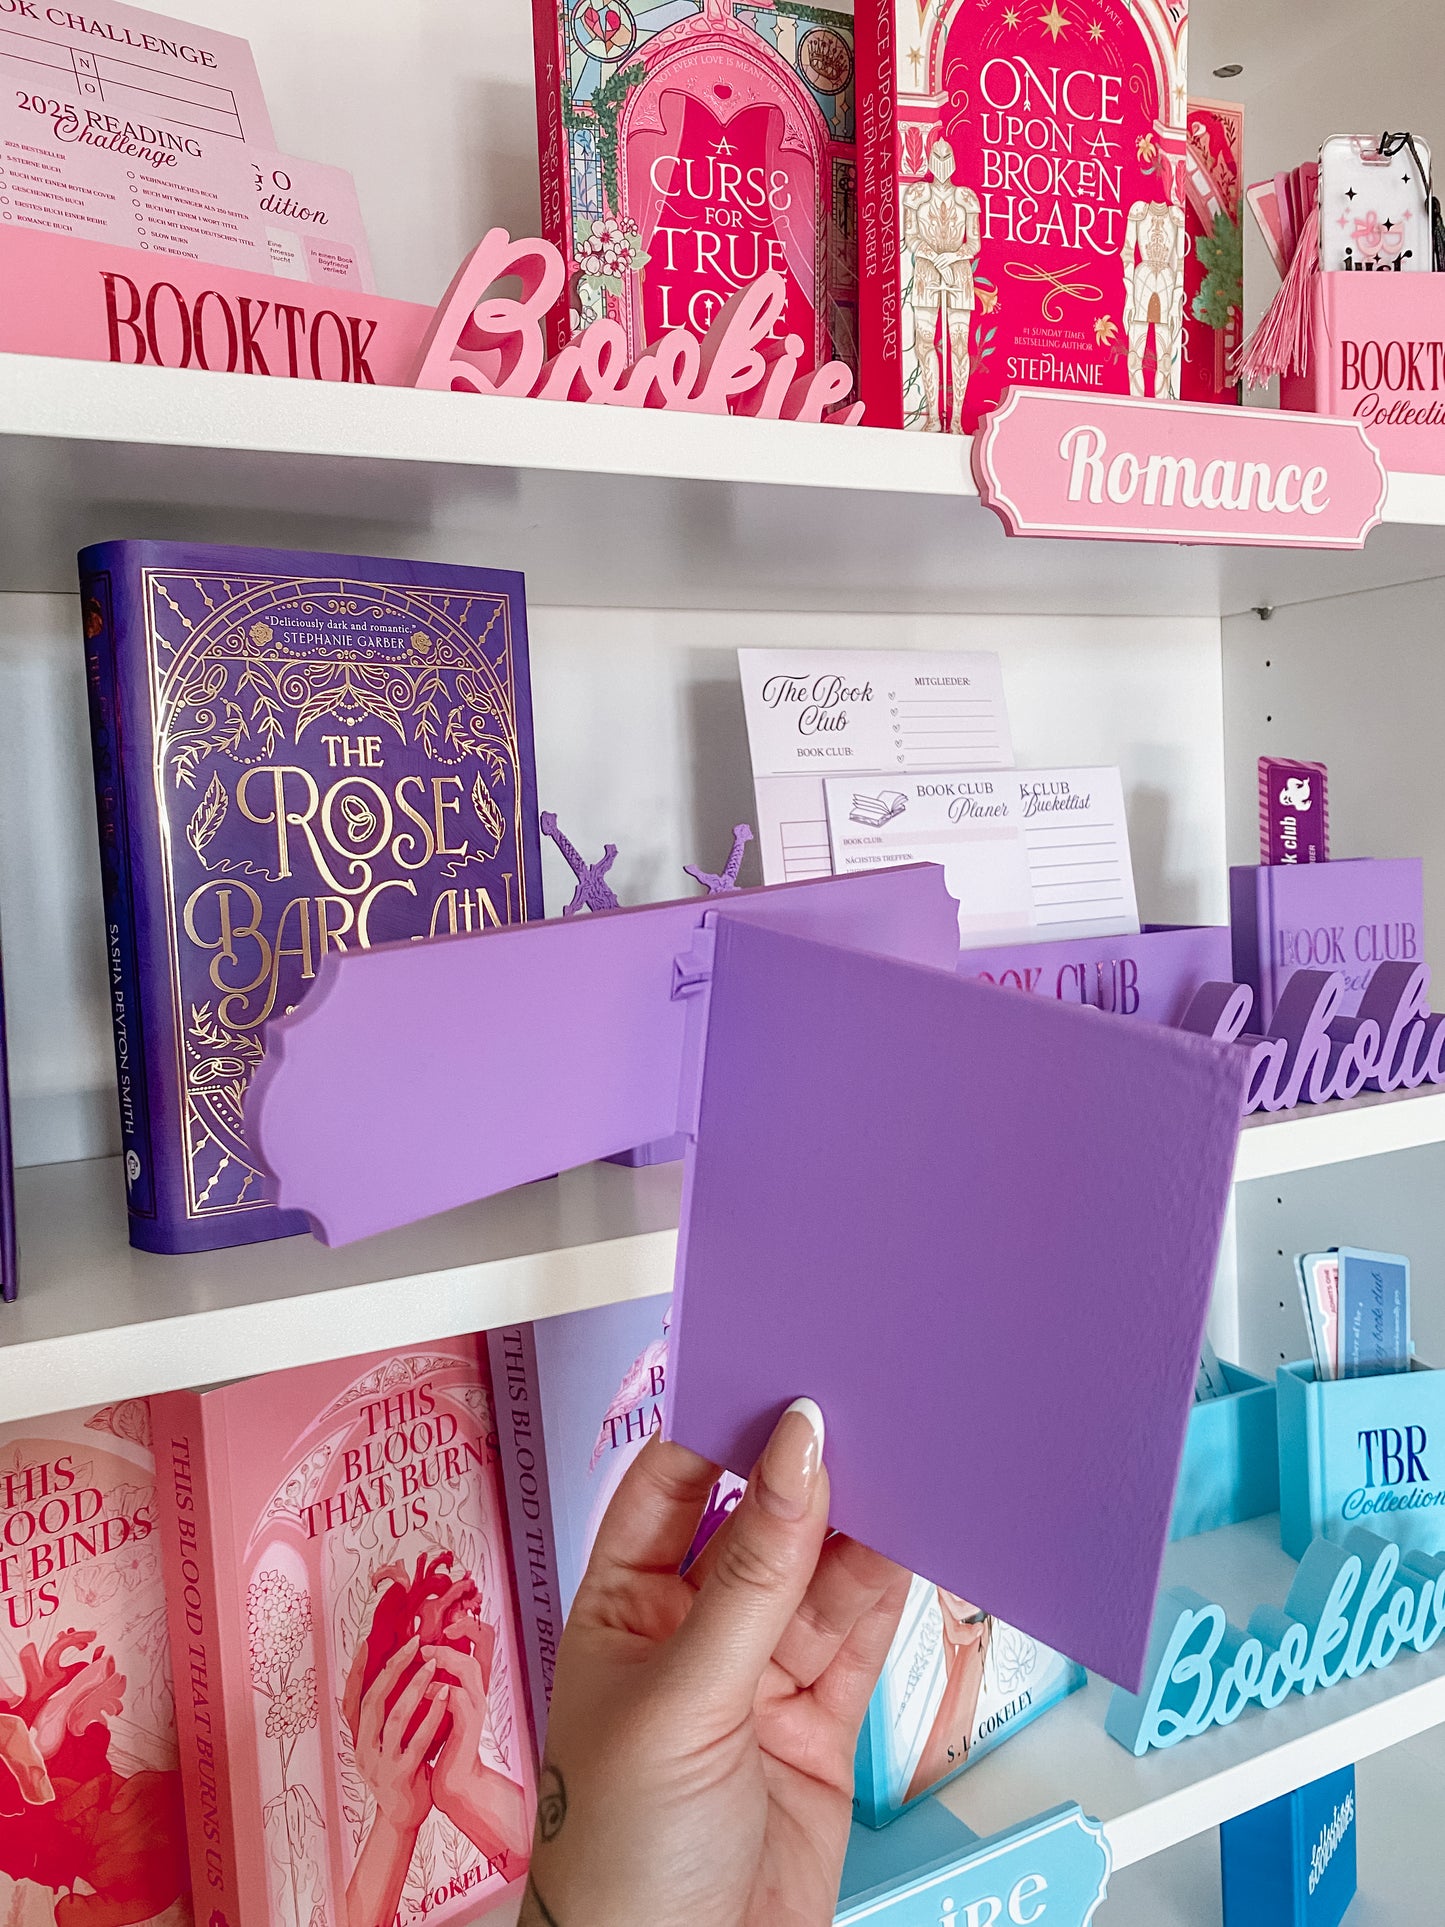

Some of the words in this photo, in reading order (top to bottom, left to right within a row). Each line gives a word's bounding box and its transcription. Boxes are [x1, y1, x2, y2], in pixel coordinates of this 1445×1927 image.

[46, 8, 218, 69] CHALLENGE
[79, 57, 91, 69] N
[84, 83, 96, 94] O
[877, 58, 893, 142] UPON
[980, 55, 1124, 125] ONCE
[16, 91, 77, 122] 2025
[84, 109, 203, 158] READING
[53, 116, 178, 168] Challenge
[708, 136, 738, 156] A
[861, 92, 876, 202] STEPHANIE
[980, 111, 1075, 154] UPON
[1081, 127, 1121, 158] A
[650, 155, 792, 221] CURSE
[981, 148, 1123, 204] BROKEN
[259, 194, 329, 225] dition
[705, 207, 744, 229] FOR
[879, 173, 895, 275] BROKEN
[981, 192, 1123, 256] HEART
[654, 226, 788, 290] TRUE
[861, 202, 877, 279] GARBER
[99, 270, 378, 386] BOOKTOK
[413, 227, 866, 427] Bookie
[658, 285, 789, 340] LO
[1007, 352, 1104, 386] STEPHANIE
[1014, 336, 1061, 349] BESTSELLING
[1061, 340, 1093, 351] AUTHOR
[1340, 340, 1445, 391] BOOKT
[1058, 424, 1331, 515] Romance
[283, 631, 353, 647] STEPHANIE
[357, 635, 406, 650] GARBER
[327, 619, 348, 630] dark
[350, 622, 367, 631] and
[762, 675, 810, 709] The
[811, 674, 874, 709] Book
[914, 676, 971, 687] MITGLIEDER:
[797, 704, 850, 736] Club
[321, 735, 384, 768] THE
[796, 748, 824, 758] BOOK
[825, 747, 854, 757] CLUB:
[916, 783, 955, 797] BOOK
[957, 781, 994, 795] CLUB
[947, 796, 1009, 824] Planer
[1023, 791, 1091, 818] Bucketlist
[1032, 781, 1071, 795] CLUB
[236, 765, 469, 896] ROSE
[843, 837, 863, 845] BOOK
[1280, 816, 1297, 850] club
[109, 924, 122, 985] SASHA
[1279, 926, 1346, 967] BOOK
[1355, 922, 1417, 962] CLUB
[114, 990, 129, 1070] PEYTON
[121, 1075, 135, 1135] SMITH
[503, 1329, 528, 1402] THIS
[359, 1382, 436, 1437] THIS
[171, 1436, 194, 1512] THIS
[342, 1413, 458, 1485] BLOOD
[511, 1406, 541, 1521] BLOOD
[1357, 1425, 1431, 1489] TBR
[2, 1455, 75, 1510] HIS
[300, 1472, 393, 1540] THAT
[400, 1431, 500, 1499] BURNS
[28, 1505, 152, 1582] BINDS
[387, 1496, 429, 1539] US
[177, 1517, 202, 1637] BLOOD
[525, 1527, 551, 1602] THAT
[4, 1579, 60, 1629] US
[188, 1640, 213, 1733] THAT
[978, 1686, 1033, 1739] COKELEY
[196, 1732, 222, 1842] BURNS
[204, 1841, 225, 1892] US
